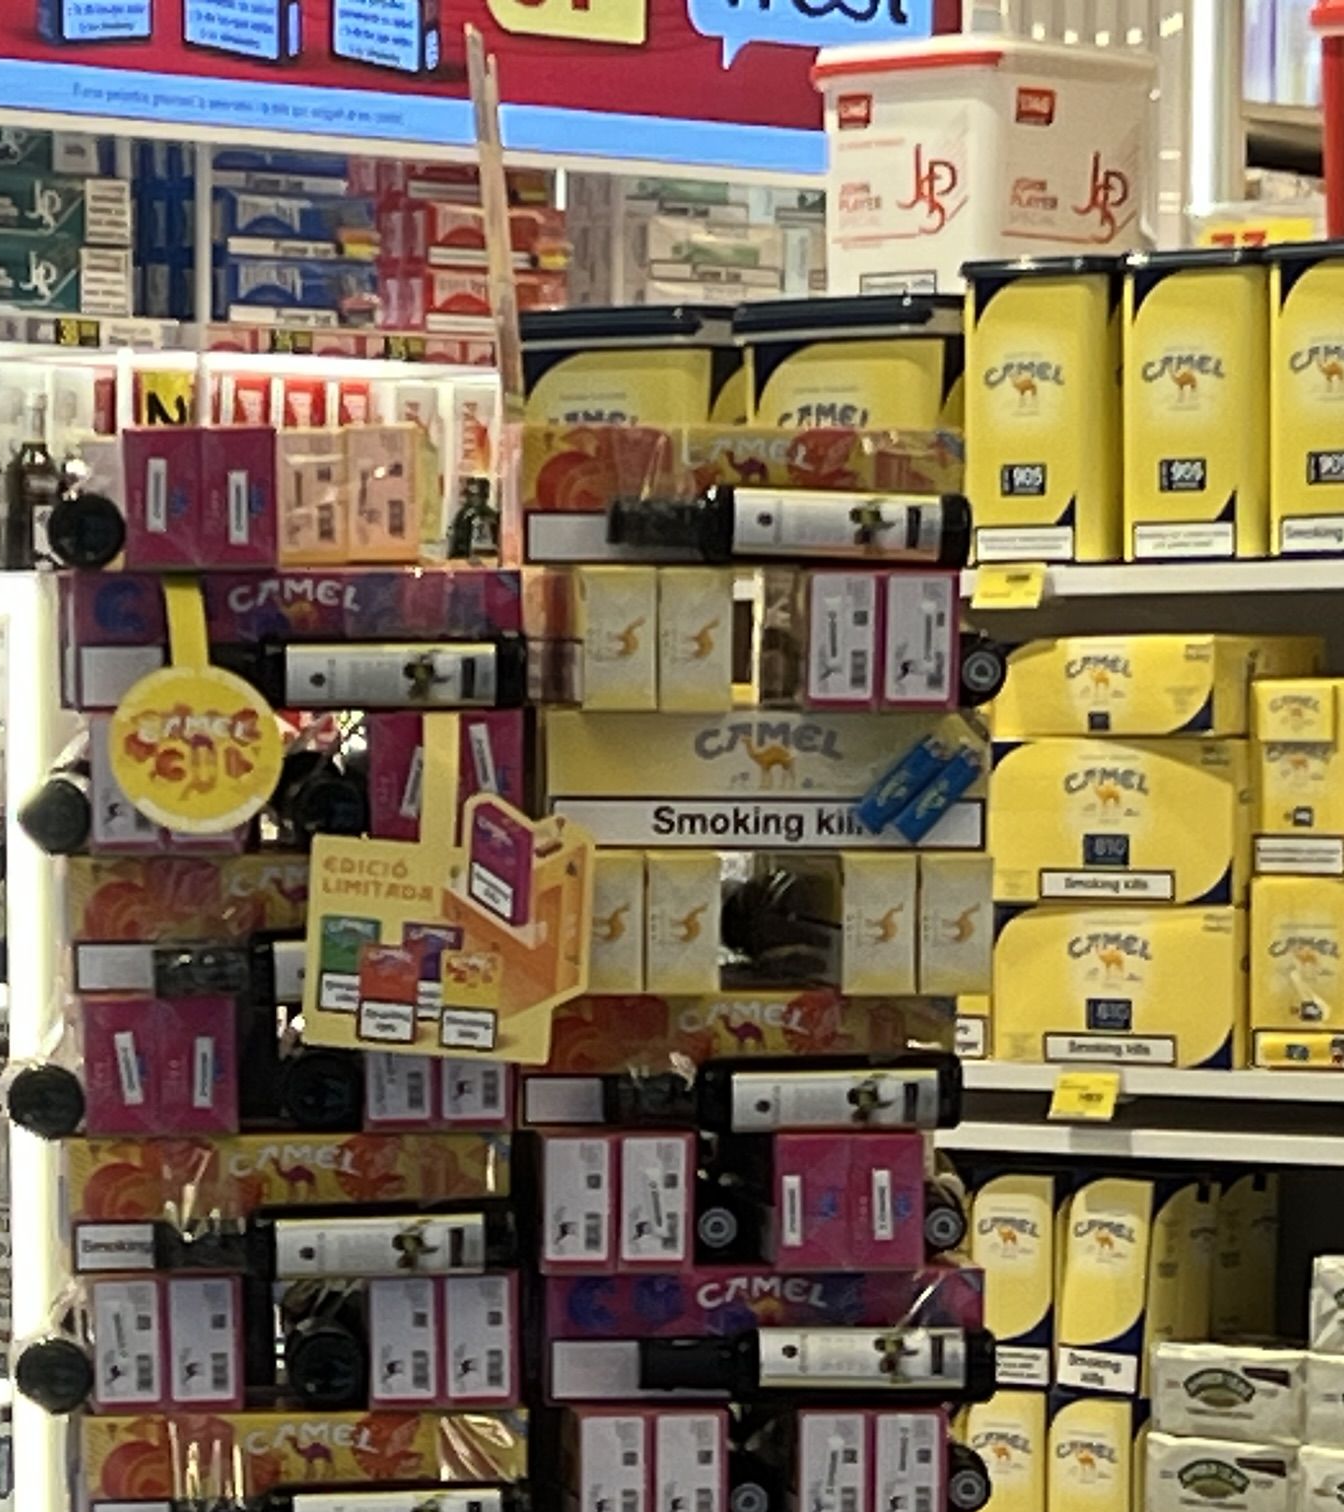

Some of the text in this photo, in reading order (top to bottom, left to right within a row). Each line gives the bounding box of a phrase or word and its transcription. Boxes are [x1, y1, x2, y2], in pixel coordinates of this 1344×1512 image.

[985, 363, 1066, 388] CAMEL
[1142, 354, 1225, 382] CAMEL
[682, 438, 811, 467] CAMEL
[229, 578, 361, 613] CAMEL
[1064, 655, 1133, 679] CAMEL
[1269, 695, 1321, 715] CAMEL
[694, 722, 844, 761] CAMEL
[1064, 766, 1150, 796] CAMEL
[653, 806, 806, 841] Smoking
[323, 856, 408, 879] EDICIÓ
[322, 879, 434, 901] LIMITADA
[1067, 931, 1153, 961] CAMEL
[1268, 935, 1340, 961] CAMEL
[680, 1003, 809, 1034] CAMEL
[229, 1146, 356, 1175] CAMEL
[977, 1216, 1041, 1240] CAMEL
[1072, 1217, 1137, 1243] CAMEL
[697, 1275, 828, 1308] CAMEL
[244, 1422, 377, 1454] CAMEL
[972, 1430, 1033, 1456] CAMEL
[1056, 1438, 1118, 1464] CAMEL
